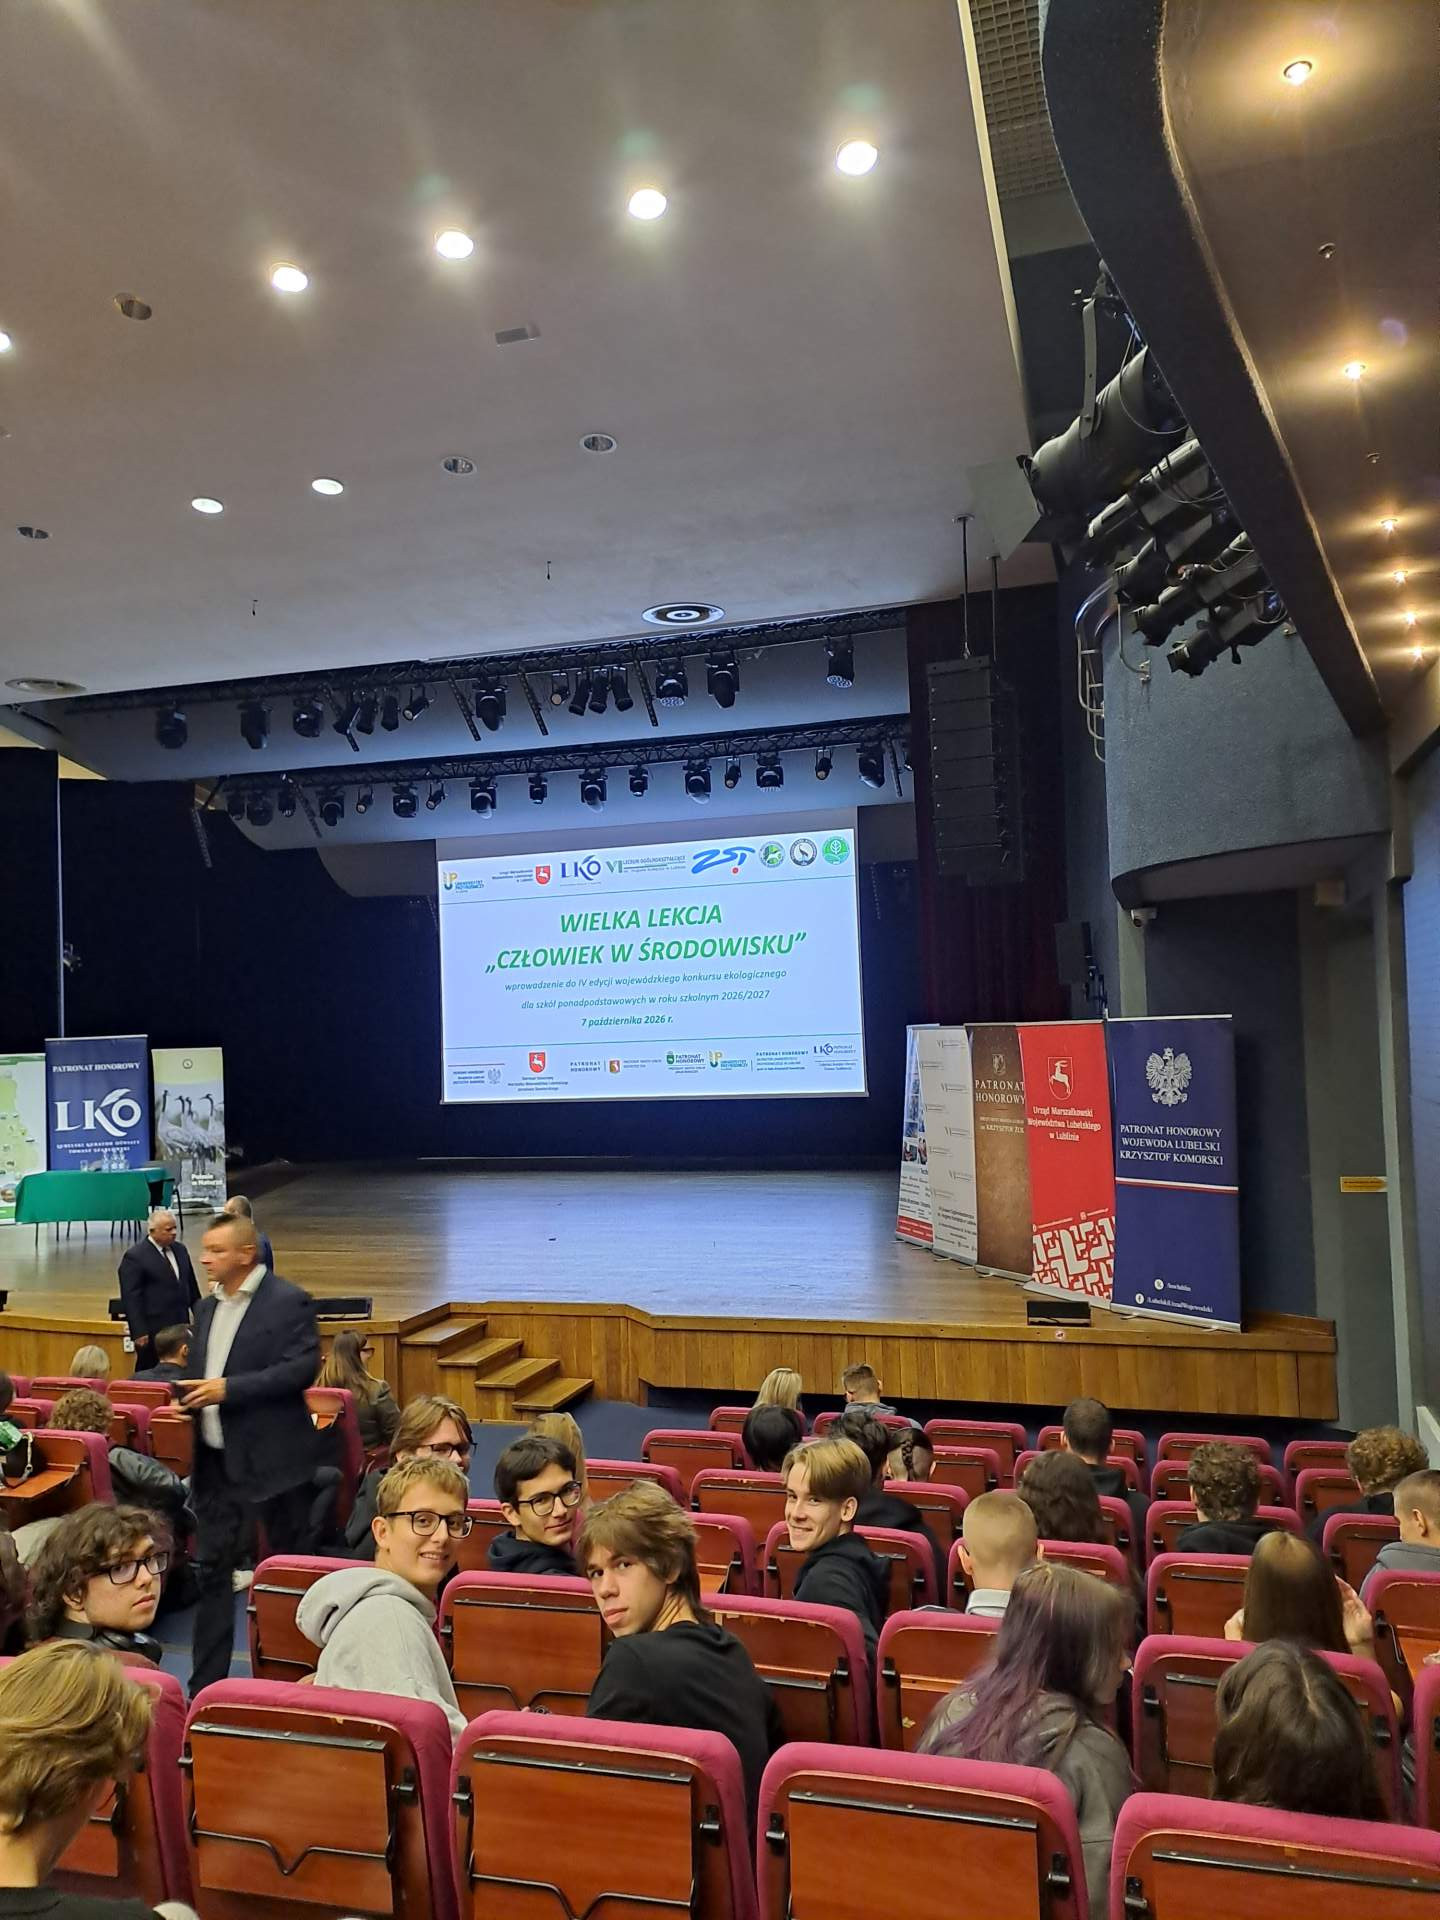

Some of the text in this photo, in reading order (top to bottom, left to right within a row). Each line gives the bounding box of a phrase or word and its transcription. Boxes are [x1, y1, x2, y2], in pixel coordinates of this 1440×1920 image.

[606, 860, 622, 873] VI
[561, 904, 722, 933] WIELKA LEKCJA
[485, 932, 807, 974] „CZŁOWIEK W ŚRODOWISKU”
[505, 980, 564, 992] wprowadzenie
[565, 979, 576, 988] do
[578, 978, 588, 987] IV
[589, 976, 613, 989] edycji
[683, 971, 722, 983] konkursu
[724, 968, 787, 981] ekologicznego
[521, 989, 771, 1009] dla szkół ponadpodstawowych w roku szkolnym 2026/2027
[581, 1015, 673, 1028] 7 października 2026 r.
[52, 1062, 140, 1073] PATRONAT HONOROWY
[975, 1079, 1025, 1091] PATRONAT
[975, 1092, 1025, 1104] HONOROWY
[54, 1088, 141, 1137] LKO
[1120, 1124, 1222, 1138] PATRONAT HONOROWY
[1122, 1137, 1221, 1151] WOJEWODA LUBELSKI
[1120, 1150, 1224, 1166] KRZYSZTOF KOMORSKI
